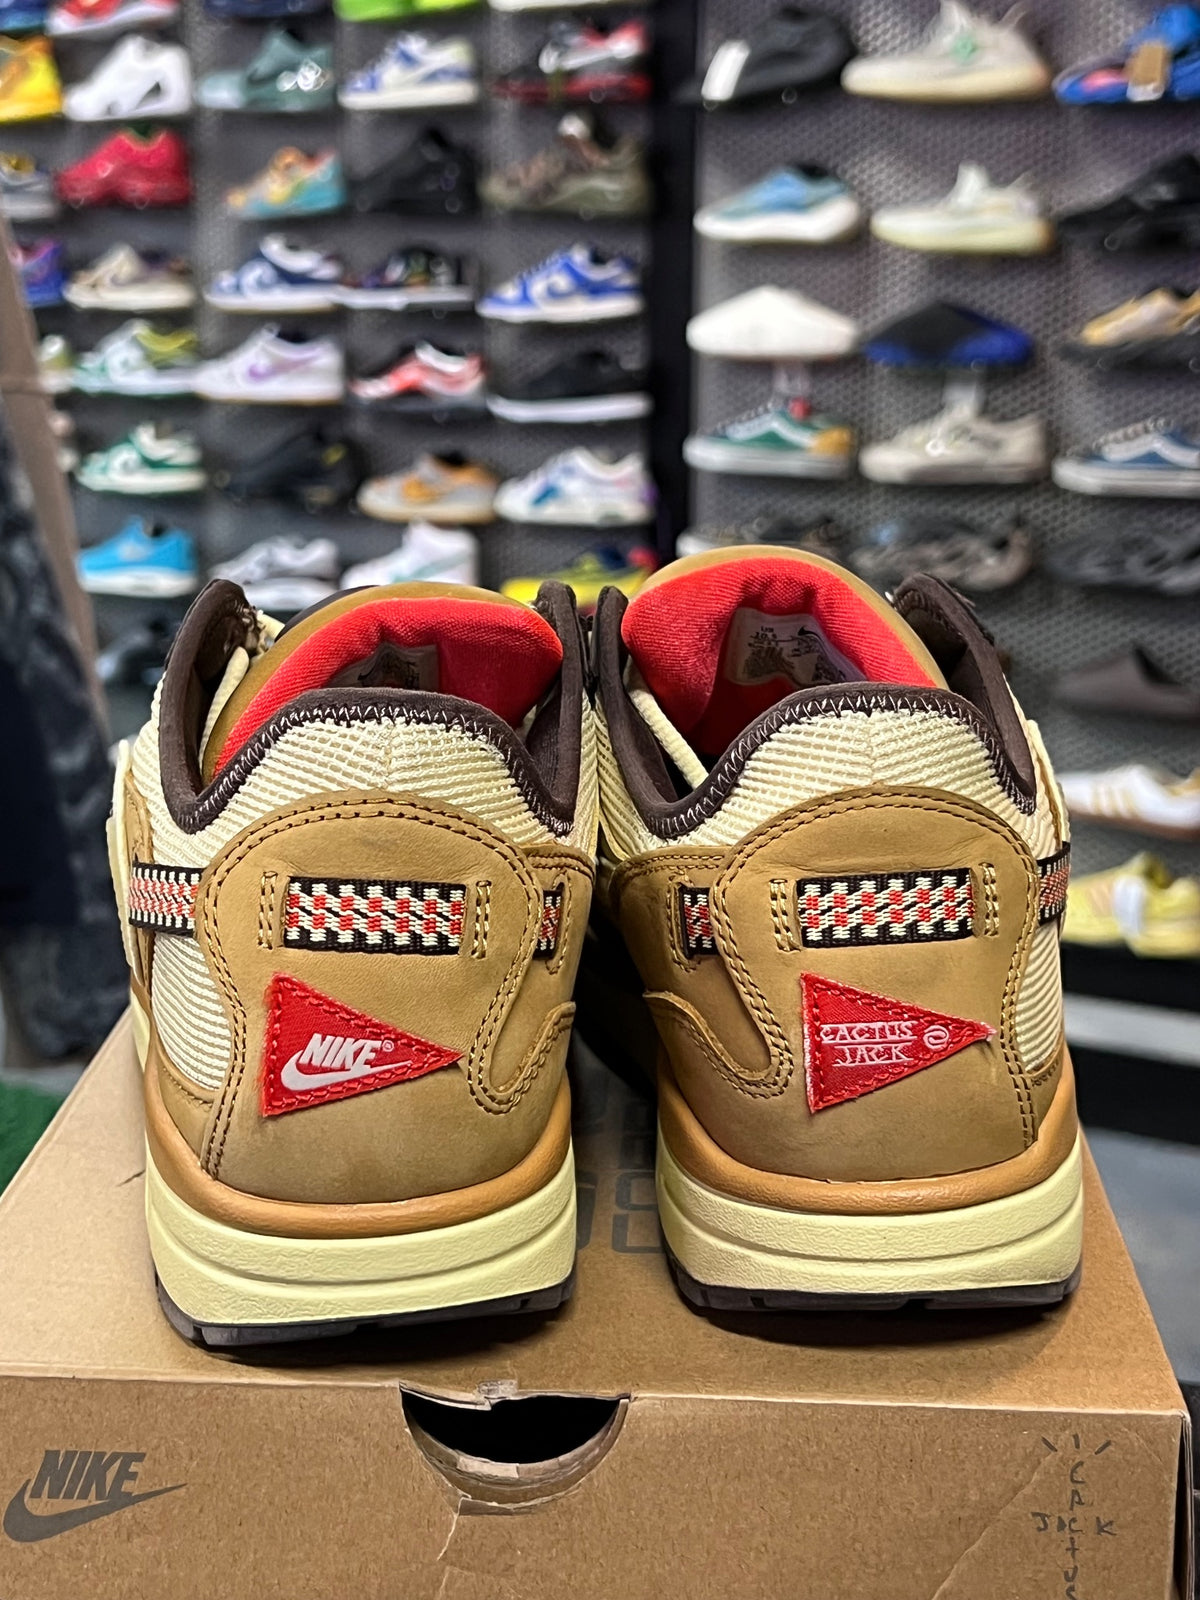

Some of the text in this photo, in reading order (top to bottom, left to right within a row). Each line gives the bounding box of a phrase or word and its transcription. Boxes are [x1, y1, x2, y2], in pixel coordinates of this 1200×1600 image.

[820, 1021, 918, 1044] CACTUS
[832, 1042, 914, 1067] JACK
[29, 1449, 147, 1501] NIKE
